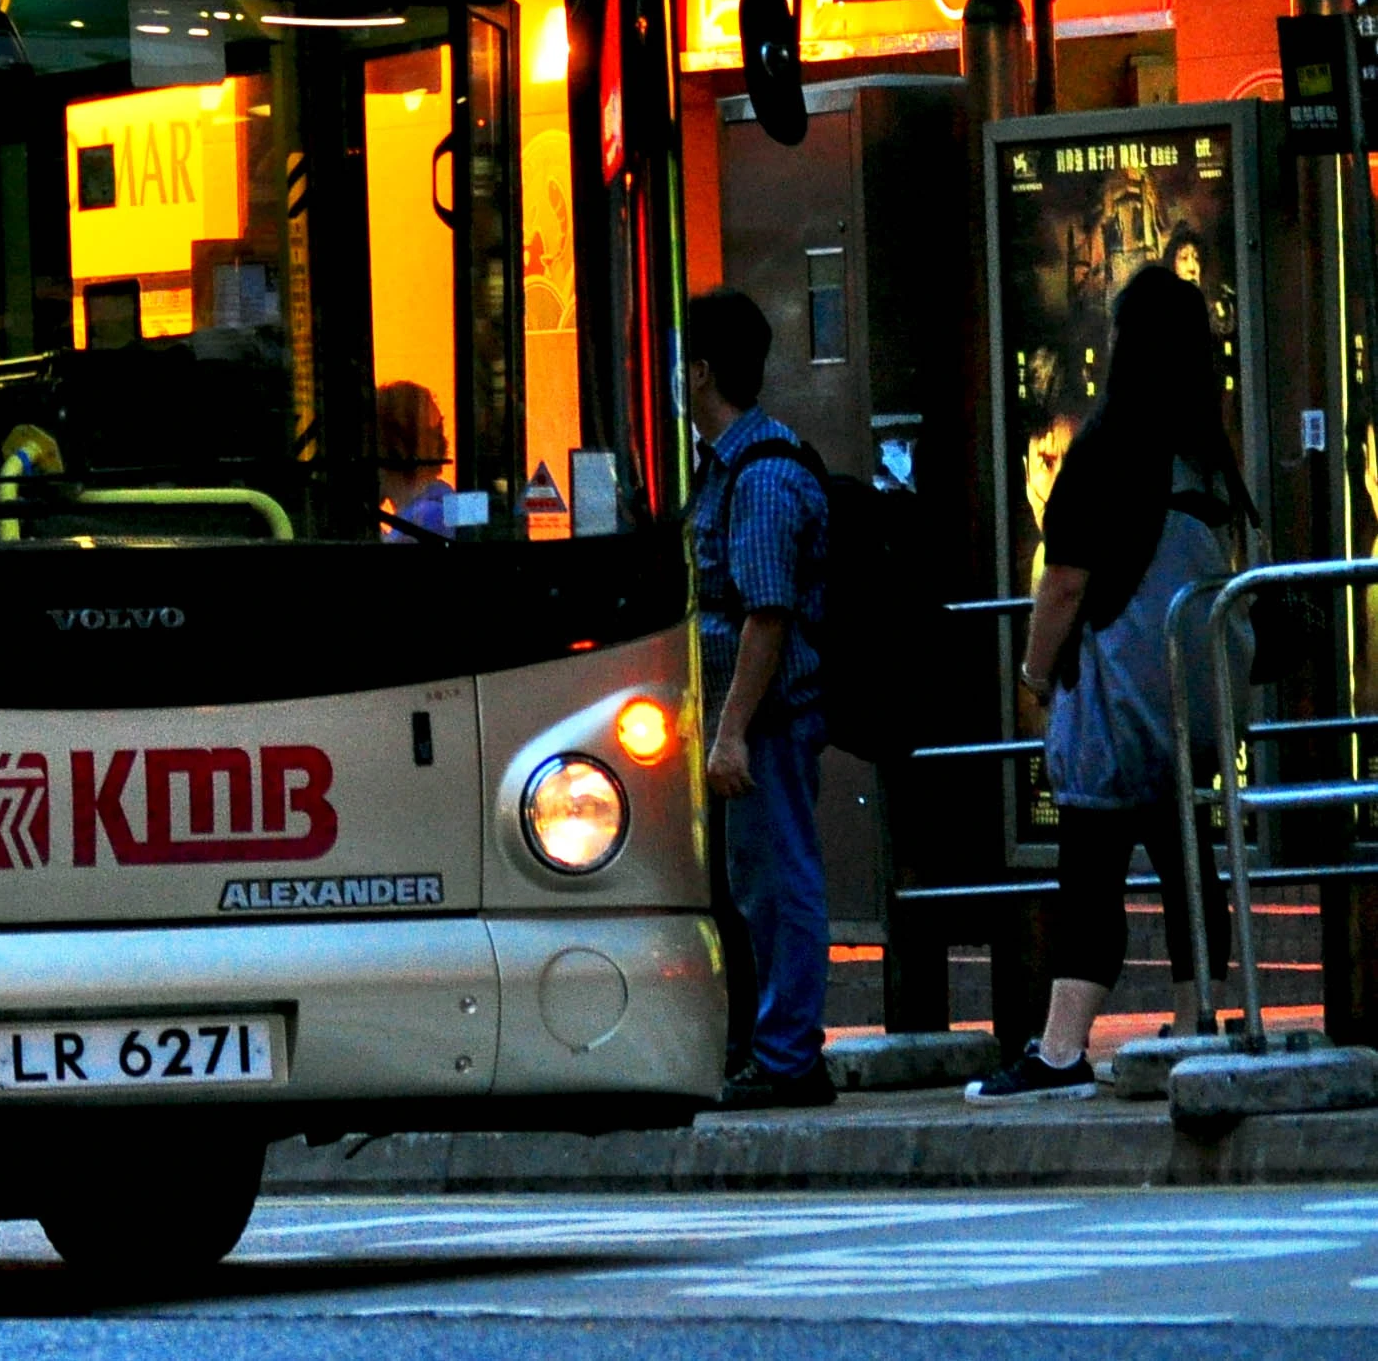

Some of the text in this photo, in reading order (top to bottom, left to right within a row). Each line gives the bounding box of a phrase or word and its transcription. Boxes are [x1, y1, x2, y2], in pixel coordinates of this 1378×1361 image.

[101, 121, 202, 207] MAR
[49, 605, 187, 631] VOLVO
[221, 877, 442, 910] ALEXANDER
[12, 1025, 252, 1082] LR 6271
